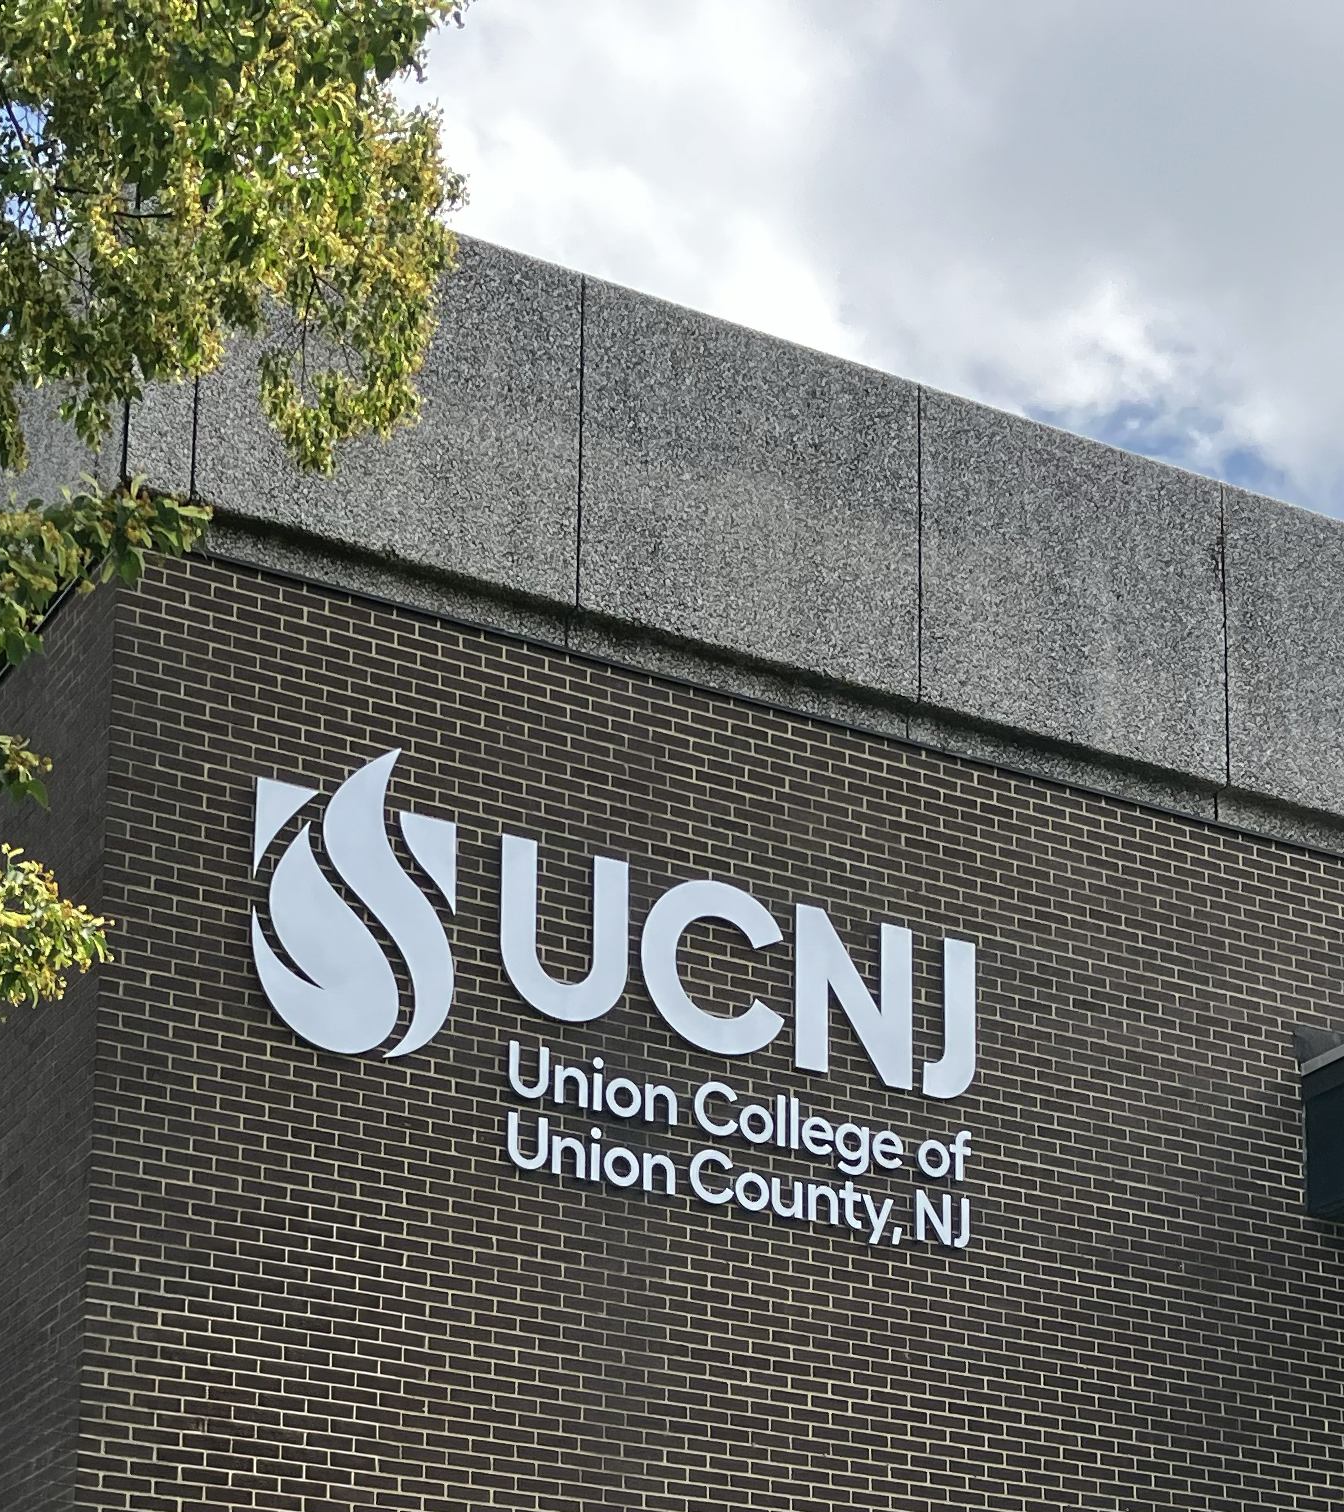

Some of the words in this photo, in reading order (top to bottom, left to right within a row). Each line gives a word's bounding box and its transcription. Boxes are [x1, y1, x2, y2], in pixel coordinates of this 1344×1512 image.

[500, 832, 977, 1099] UCNJ
[507, 1109, 677, 1197] Union
[689, 1148, 903, 1246] County,
[915, 1188, 971, 1250] NJ
[508, 1039, 678, 1126] Union
[694, 1081, 905, 1176] College
[917, 1130, 972, 1182] of
